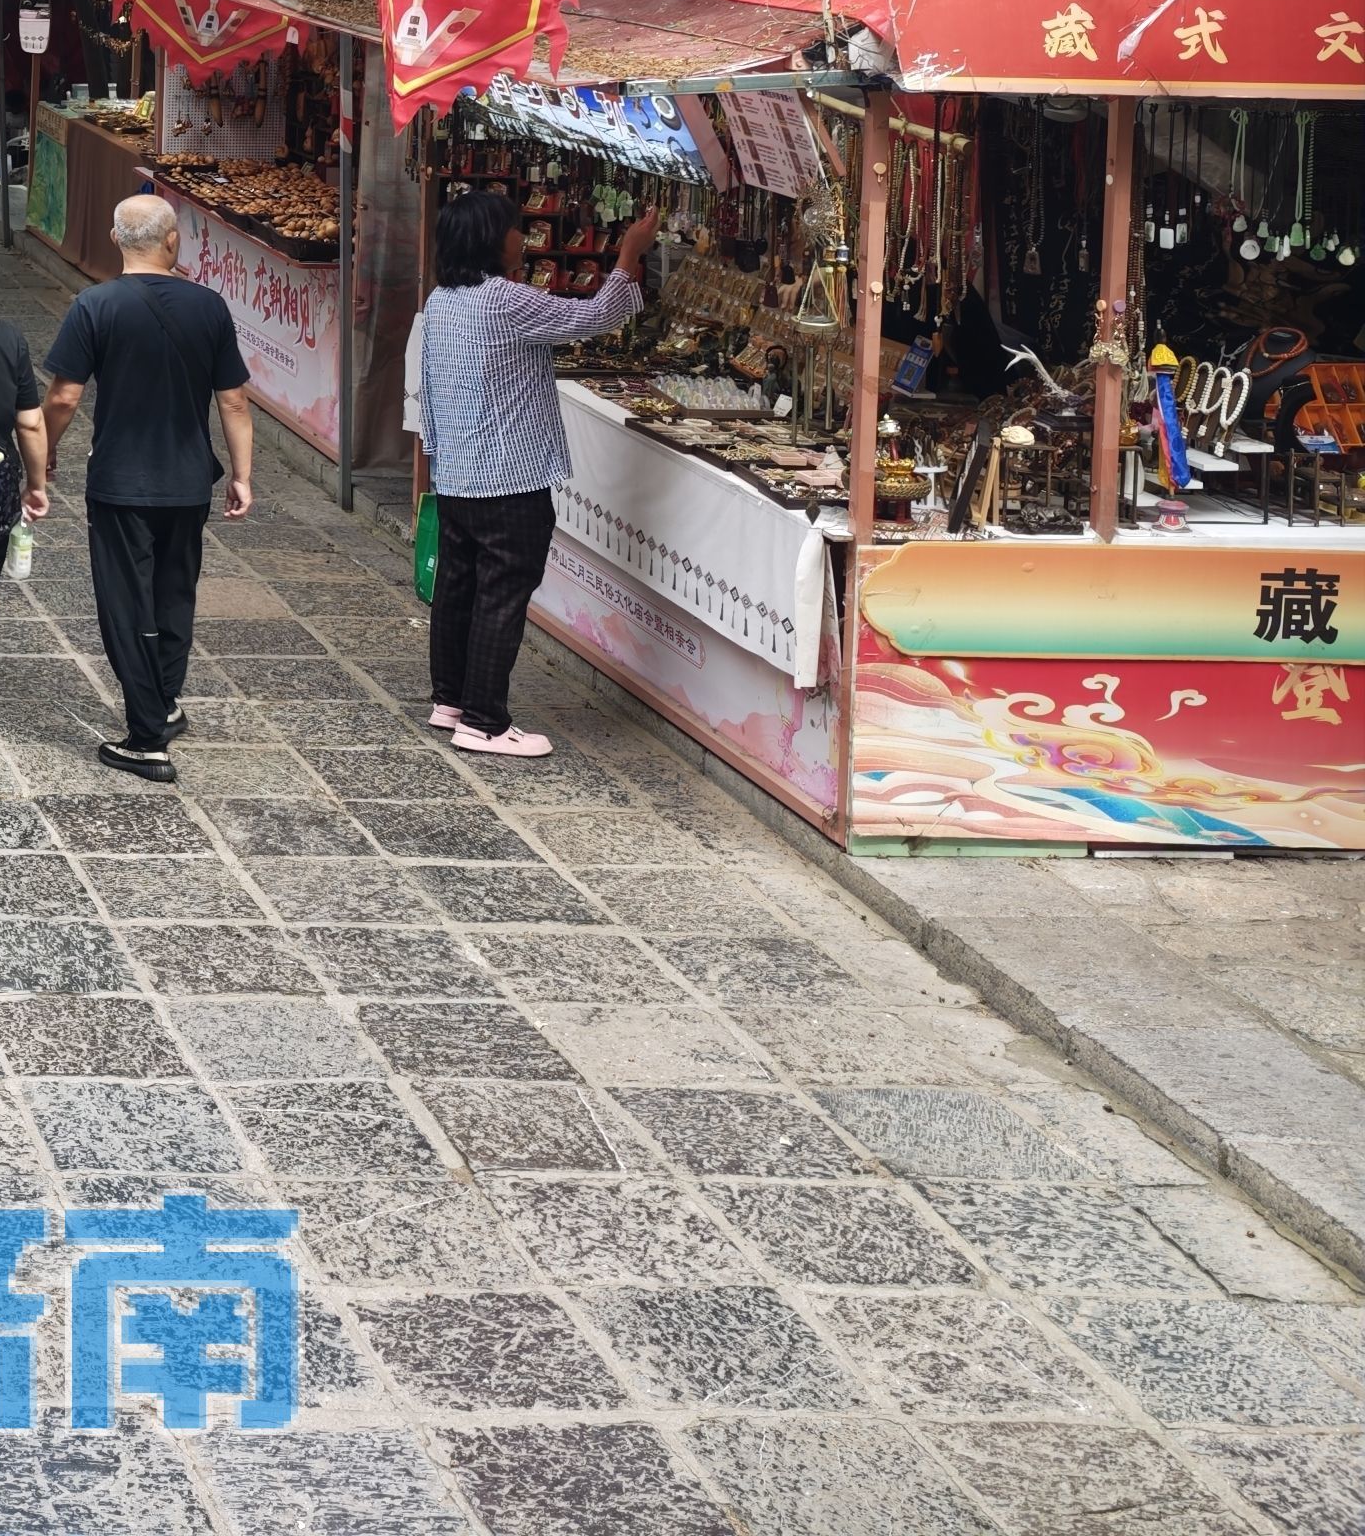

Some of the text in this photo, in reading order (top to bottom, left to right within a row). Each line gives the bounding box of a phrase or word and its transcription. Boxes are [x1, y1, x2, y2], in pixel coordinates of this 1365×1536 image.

[1041, 2, 1365, 65] 藏式文
[194, 216, 317, 349] 春山有约 花朝相见
[1252, 567, 1341, 645] 藏
